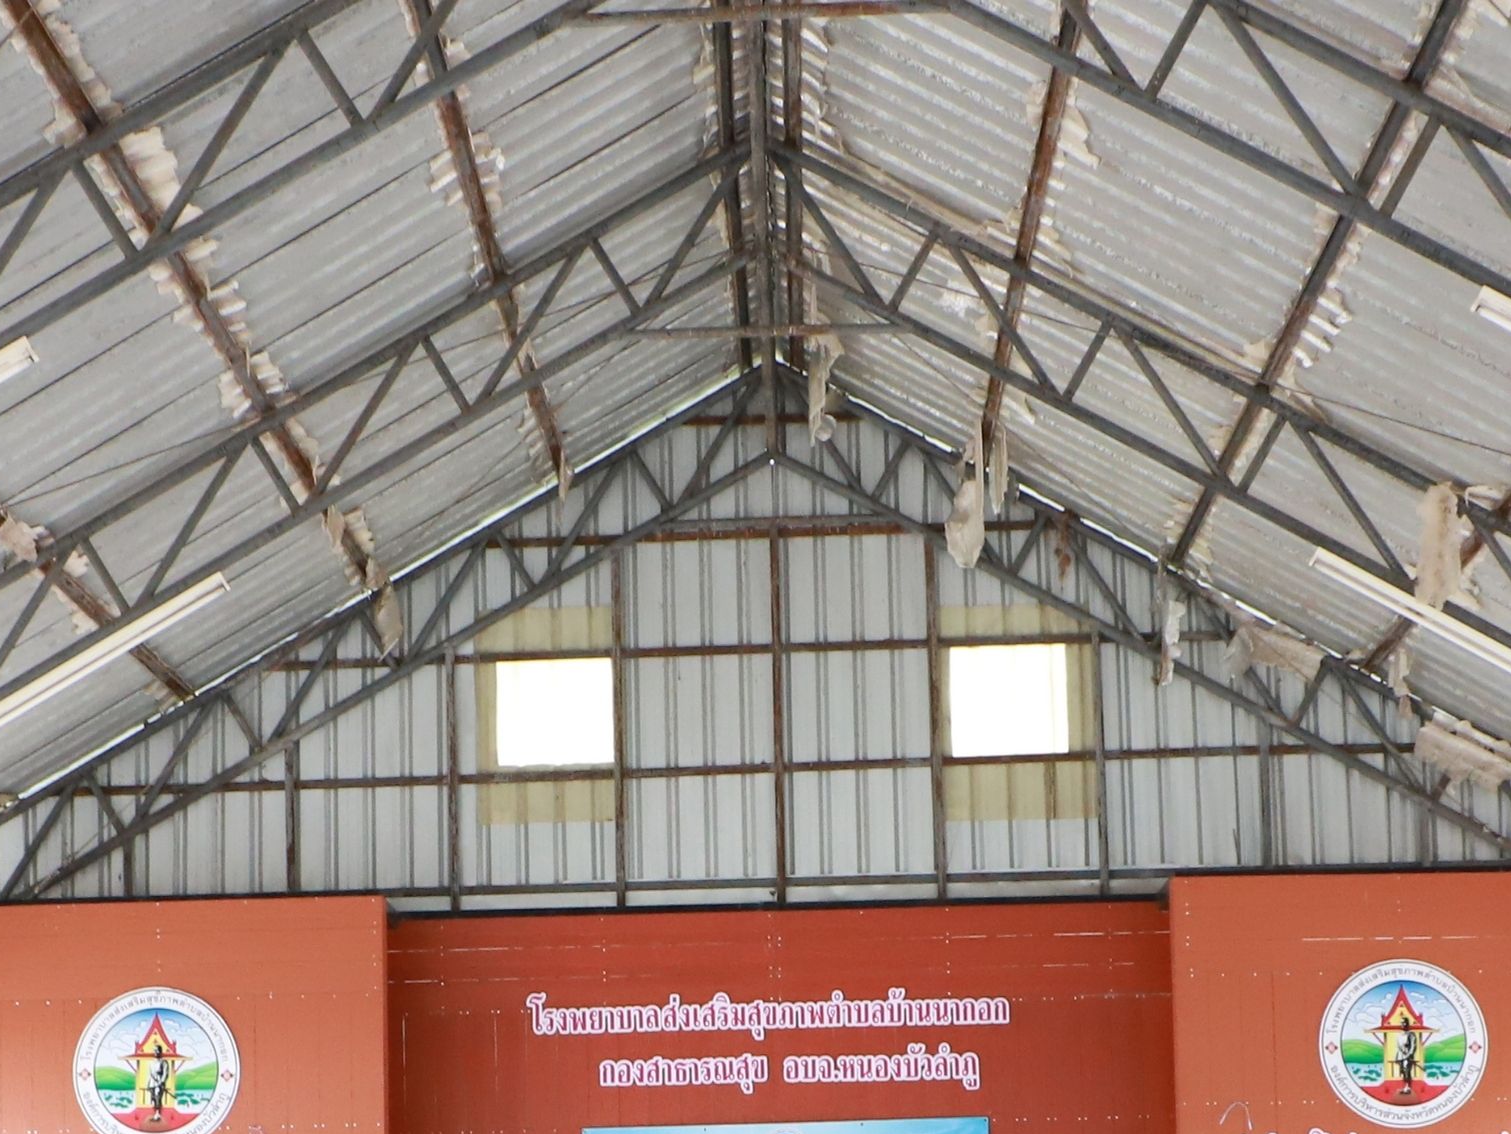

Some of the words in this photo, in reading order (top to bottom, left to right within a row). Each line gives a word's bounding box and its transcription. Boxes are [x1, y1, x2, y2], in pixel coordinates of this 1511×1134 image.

[527, 987, 1009, 1041] โรงพยาบาลส่งเสริมสุขภาพตำบลบ้านนากอก
[599, 1050, 768, 1094] กองสาธารณสุข
[783, 1043, 980, 1089] อบจ.หนองบัวลำภู
